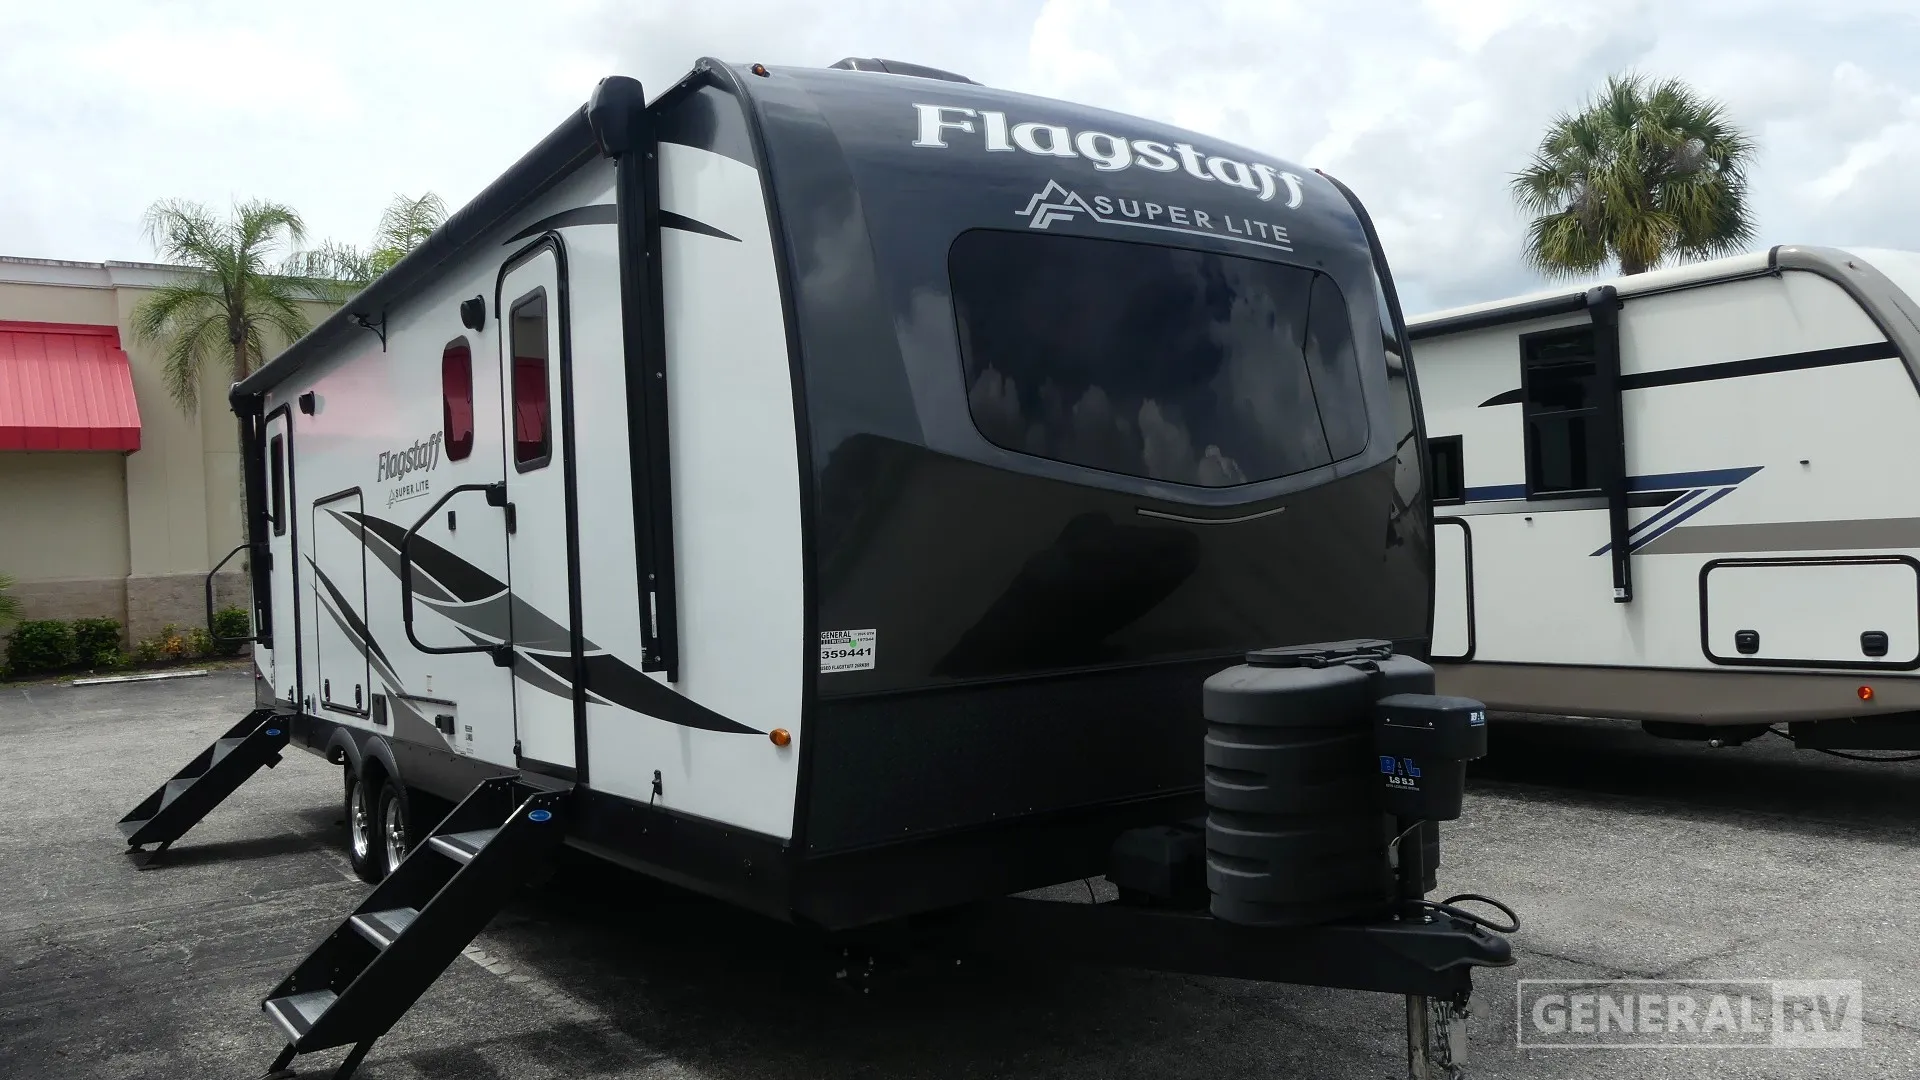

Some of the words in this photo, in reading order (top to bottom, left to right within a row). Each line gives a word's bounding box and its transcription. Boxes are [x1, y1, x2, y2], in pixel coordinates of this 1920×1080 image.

[912, 103, 1304, 210] Flagstaff
[1094, 195, 1215, 230] SUPER
[1224, 215, 1291, 244] LITE
[377, 430, 443, 482] Flagstaff
[395, 485, 414, 497] SUPER
[416, 480, 429, 492] LITE
[821, 631, 851, 639] GENERAL
[822, 648, 871, 659] 359441
[1388, 775, 1401, 785] LS
